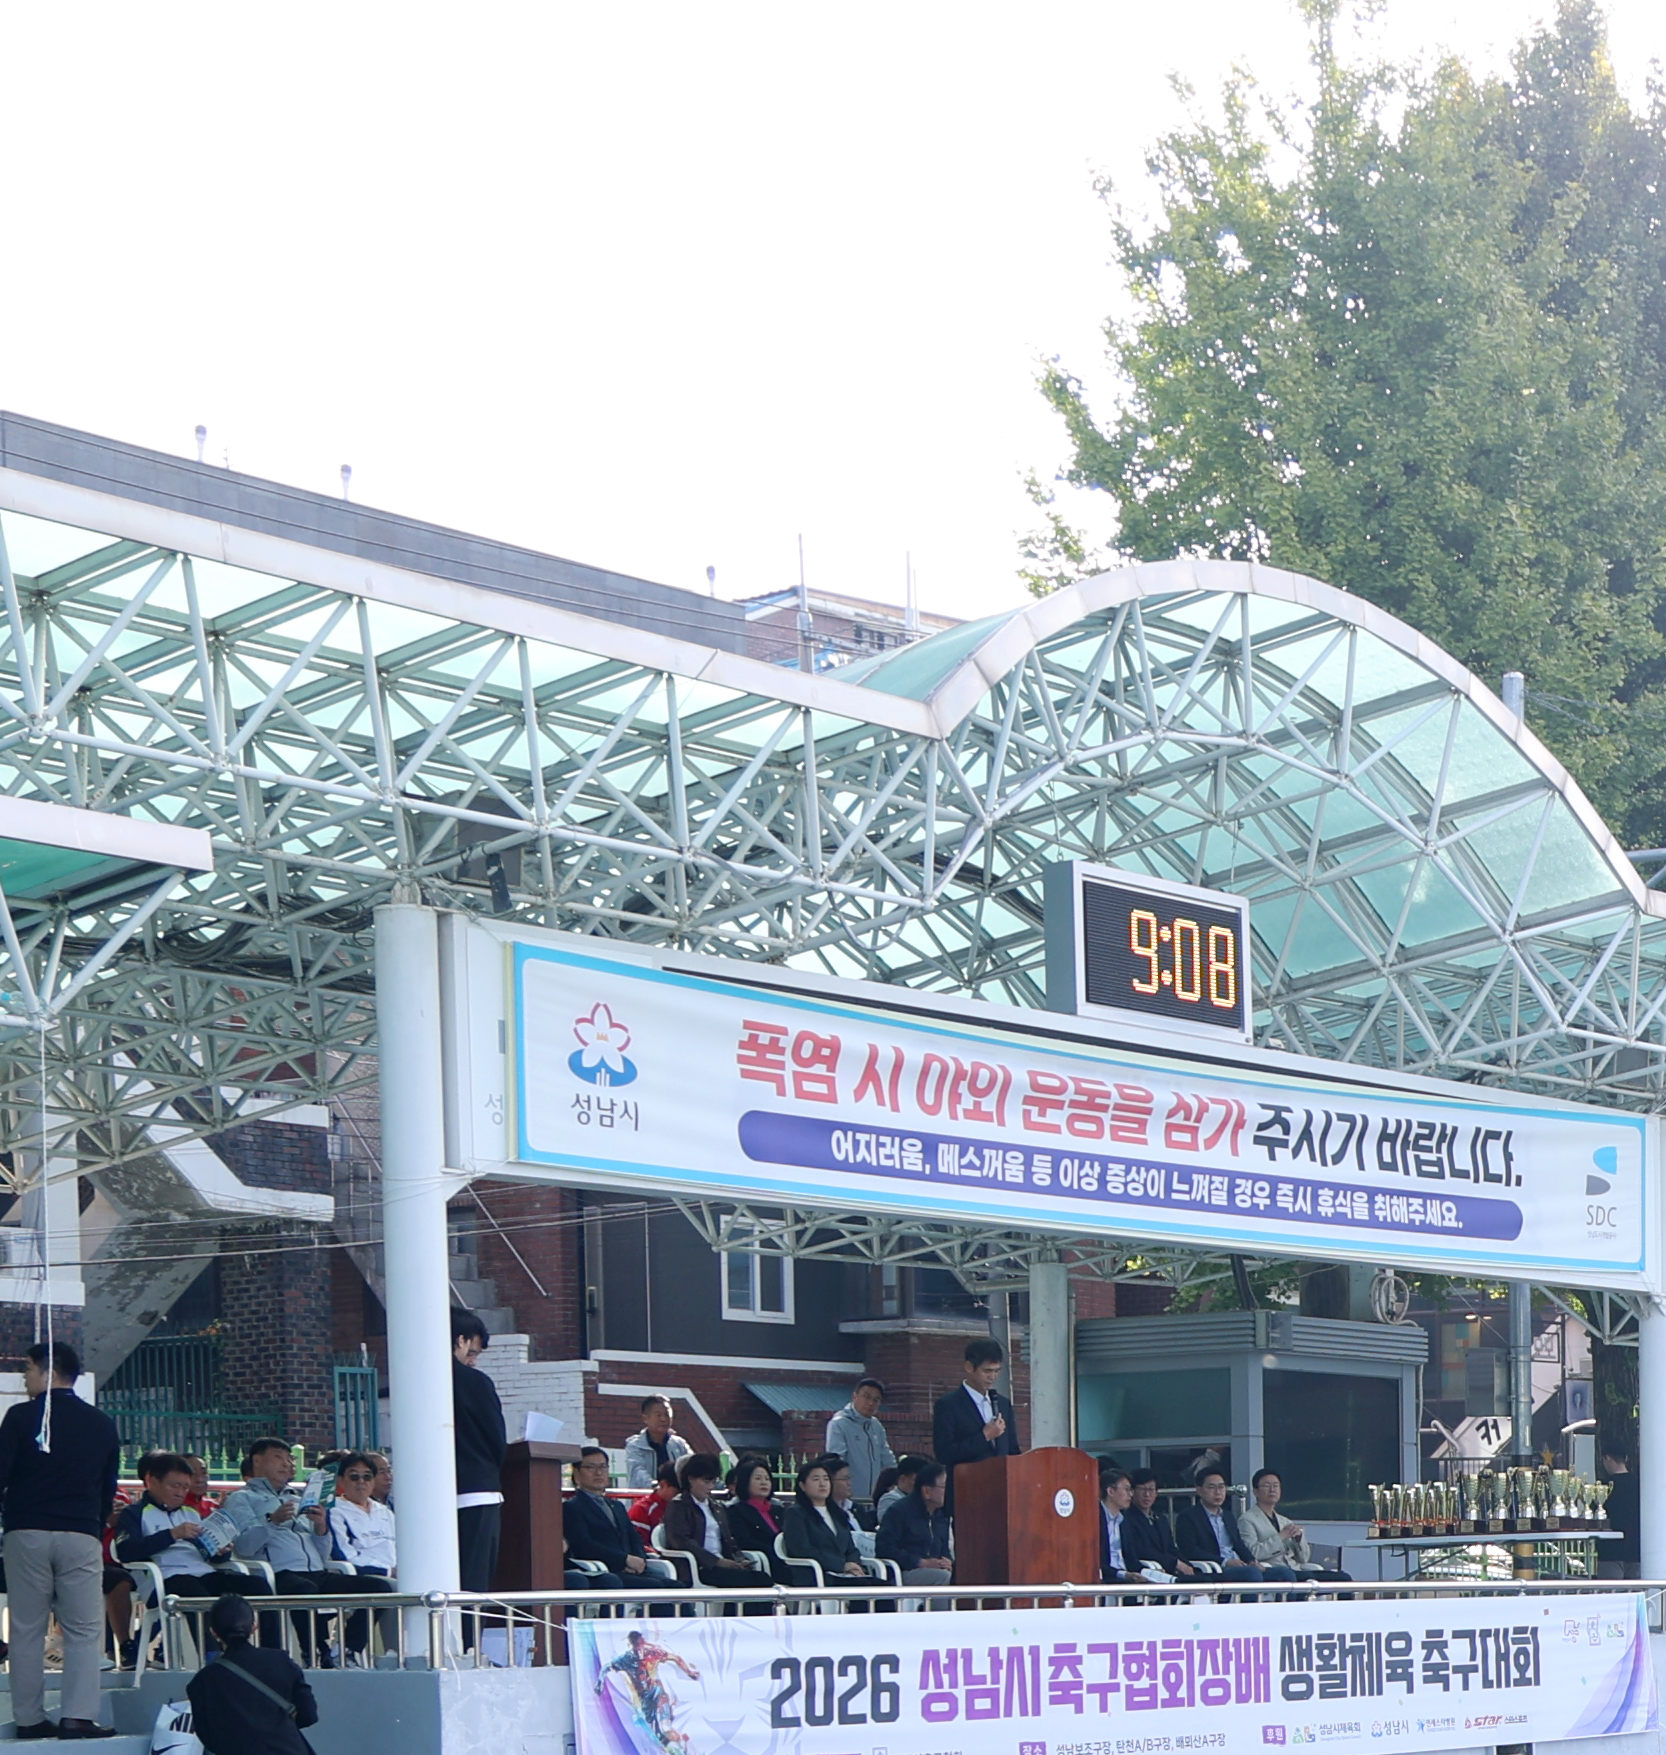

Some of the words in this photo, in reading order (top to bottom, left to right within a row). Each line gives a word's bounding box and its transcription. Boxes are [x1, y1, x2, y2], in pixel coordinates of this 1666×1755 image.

[1129, 909, 1237, 1008] 9:08
[570, 1092, 639, 1132] 성남시
[736, 1018, 842, 1105] 폭염
[853, 1042, 905, 1113] 시
[915, 1052, 1013, 1128] 야외
[1021, 1069, 1155, 1147] 운동을
[1164, 1091, 1248, 1157] 삼가
[1252, 1102, 1370, 1172] 주시기
[1375, 1116, 1523, 1188] 바랍니다.
[830, 1129, 931, 1175] 어지러움,
[937, 1143, 1025, 1184] 메스꺼움
[1031, 1153, 1053, 1187] 등
[1058, 1157, 1102, 1192] 이상
[1105, 1162, 1165, 1200] 증상이
[1170, 1171, 1229, 1206] 느껴질
[1233, 1178, 1271, 1211] 경우
[1275, 1182, 1313, 1215] 즉시
[1317, 1186, 1370, 1221] 휴식을
[1373, 1192, 1463, 1229] 취해주세요.
[1585, 1204, 1618, 1228] SDC
[769, 1653, 901, 1729] 2026
[918, 1644, 1042, 1723] 성남시
[1047, 1635, 1271, 1715] 축구협회장배
[1279, 1629, 1415, 1703] 생활체육
[1421, 1624, 1542, 1692] 축구대회
[1116, 1737, 1174, 1754] 탄천A/B구장,
[1318, 1721, 1361, 1736] 성남시체육회
[1382, 1719, 1410, 1736] 성남시
